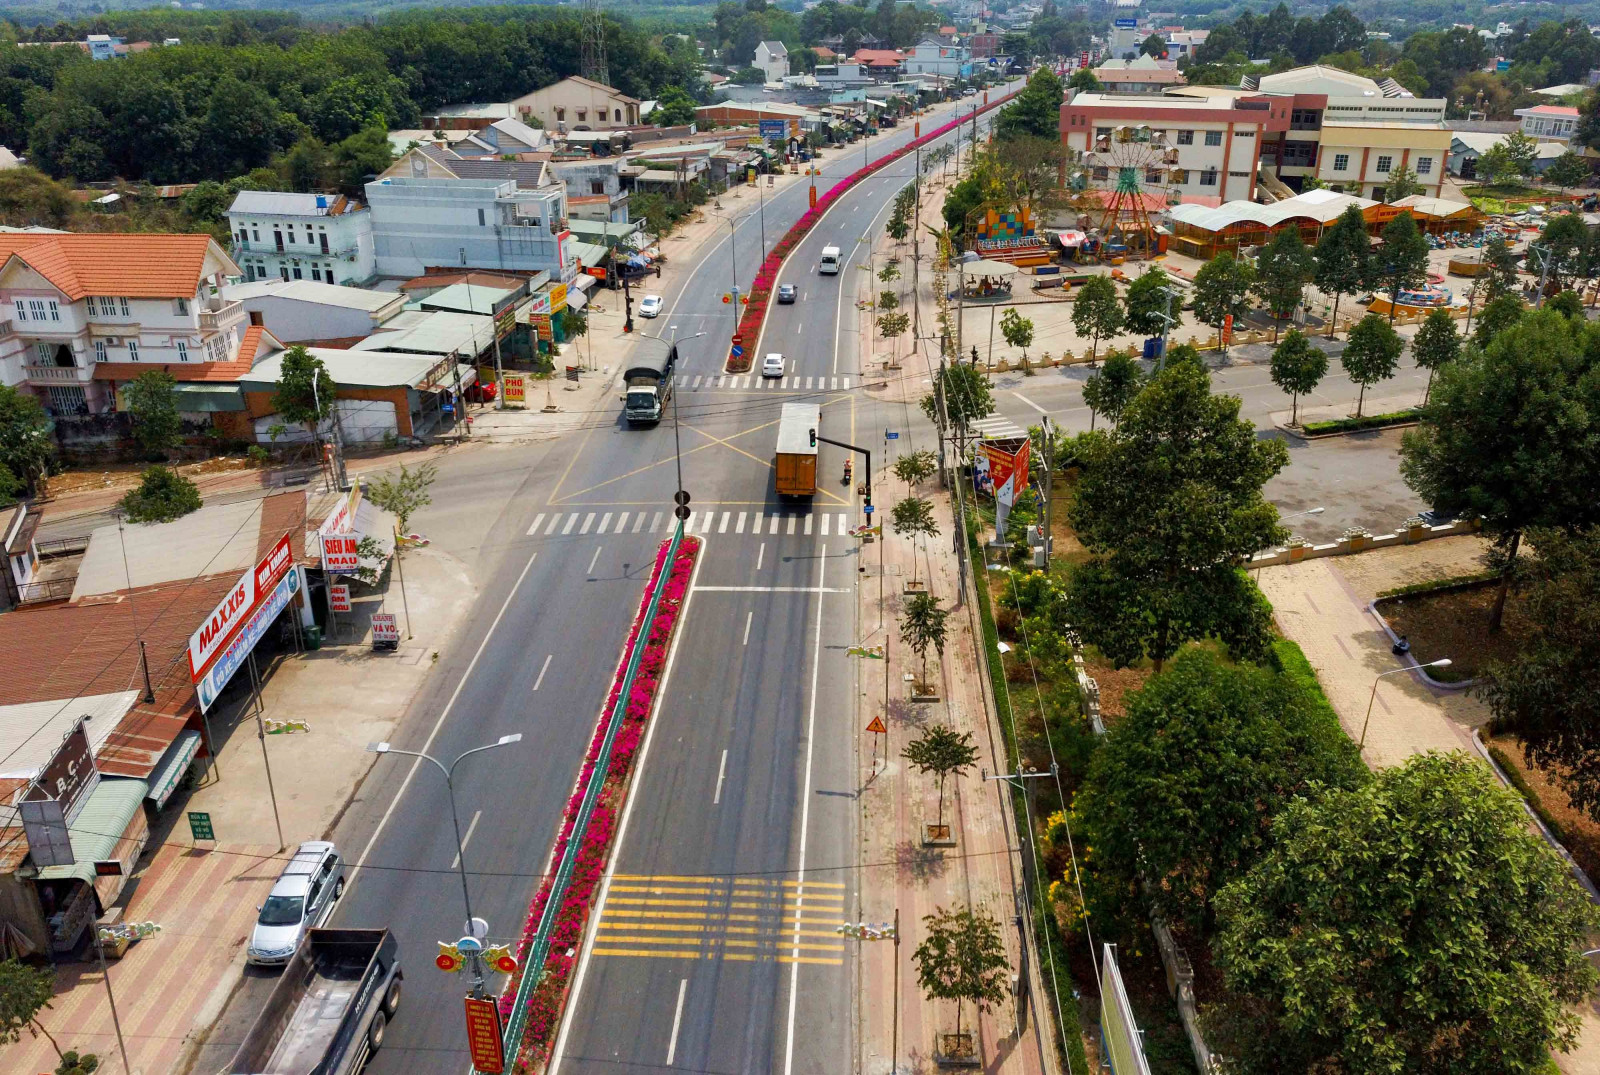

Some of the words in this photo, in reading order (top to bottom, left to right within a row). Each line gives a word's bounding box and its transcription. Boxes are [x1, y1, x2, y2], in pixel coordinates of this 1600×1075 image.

[325, 536, 342, 554] SIÊU
[258, 564, 270, 586] KIM
[200, 583, 245, 654] MAXXIS
[355, 973, 375, 1014] HYUNDAI
